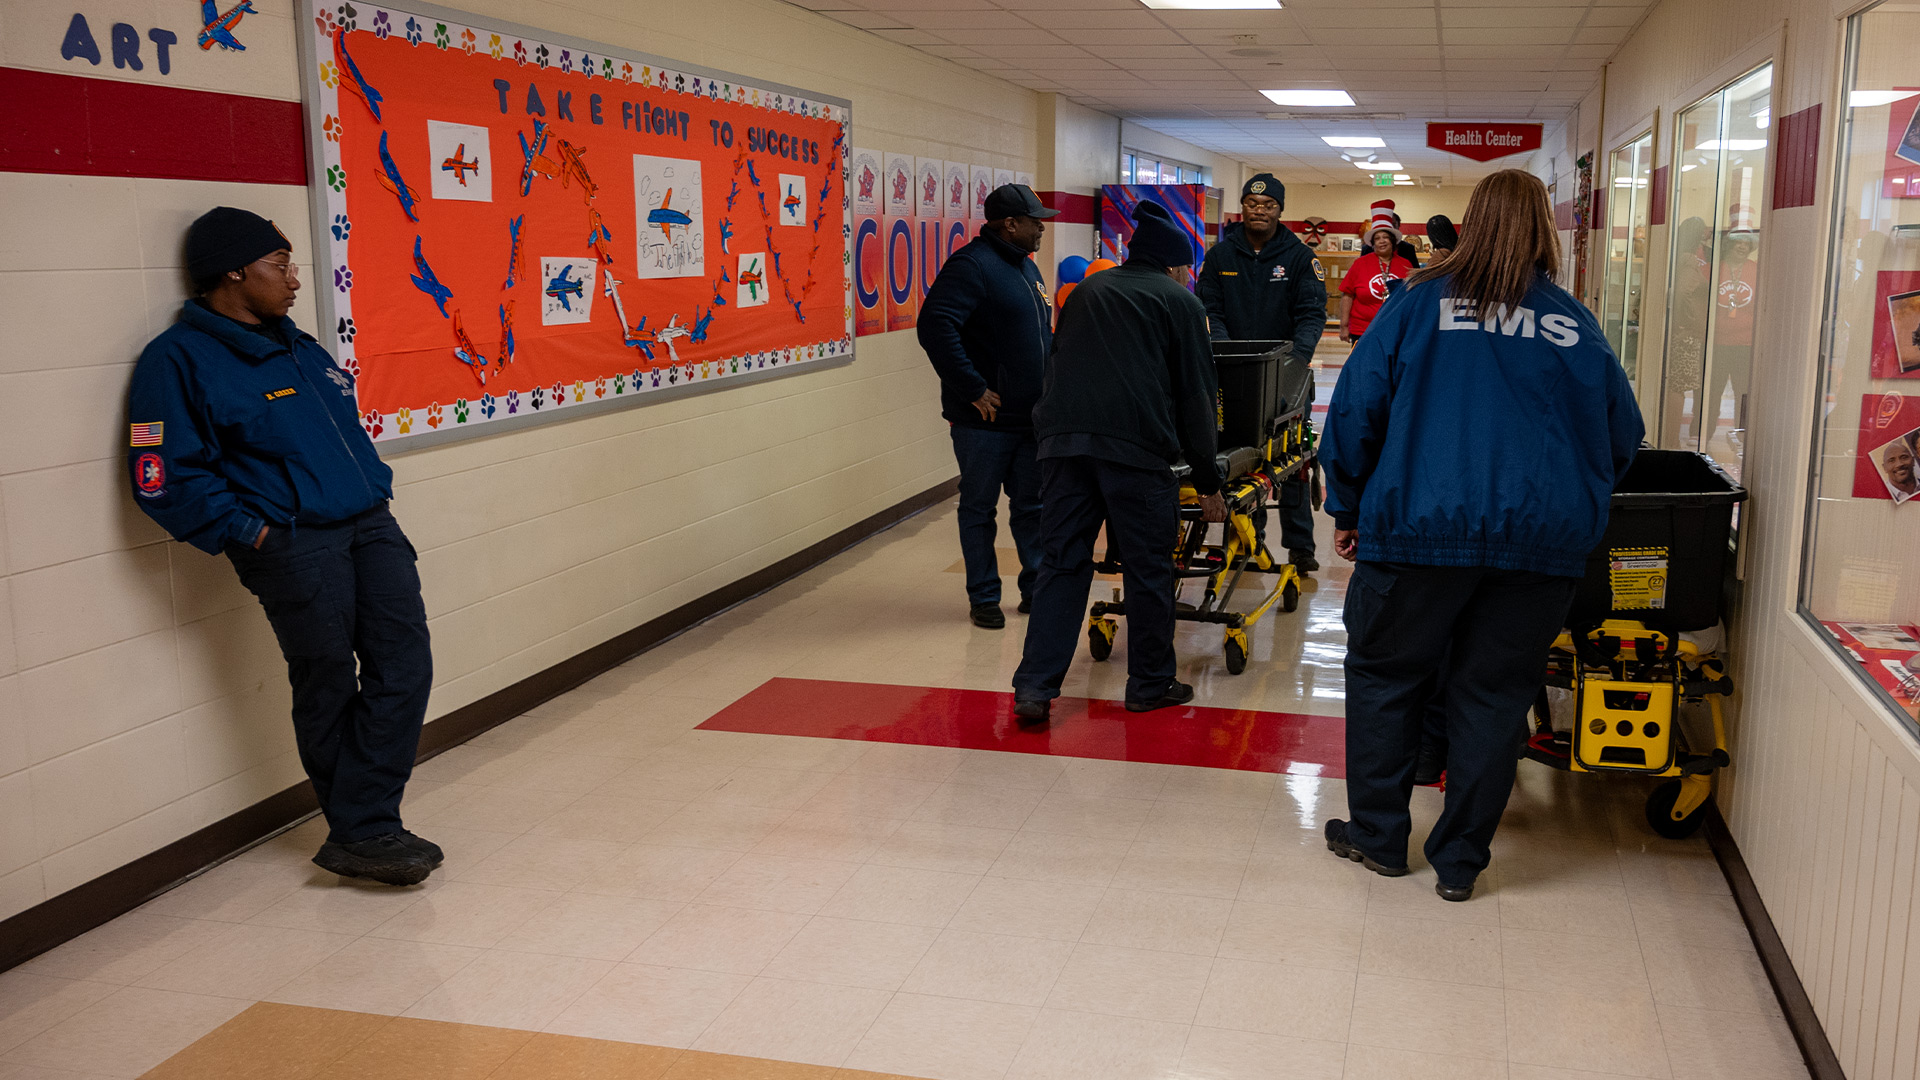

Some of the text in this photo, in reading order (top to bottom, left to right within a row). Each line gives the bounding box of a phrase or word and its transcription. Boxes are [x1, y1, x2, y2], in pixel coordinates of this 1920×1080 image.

[61, 13, 177, 76] ART
[494, 78, 604, 125] TAKE
[710, 119, 734, 149] TO
[748, 126, 819, 165] SUCCESS
[1445, 130, 1523, 147] Health Center
[1439, 298, 1579, 347] EMS
[274, 388, 297, 398] GREEN
